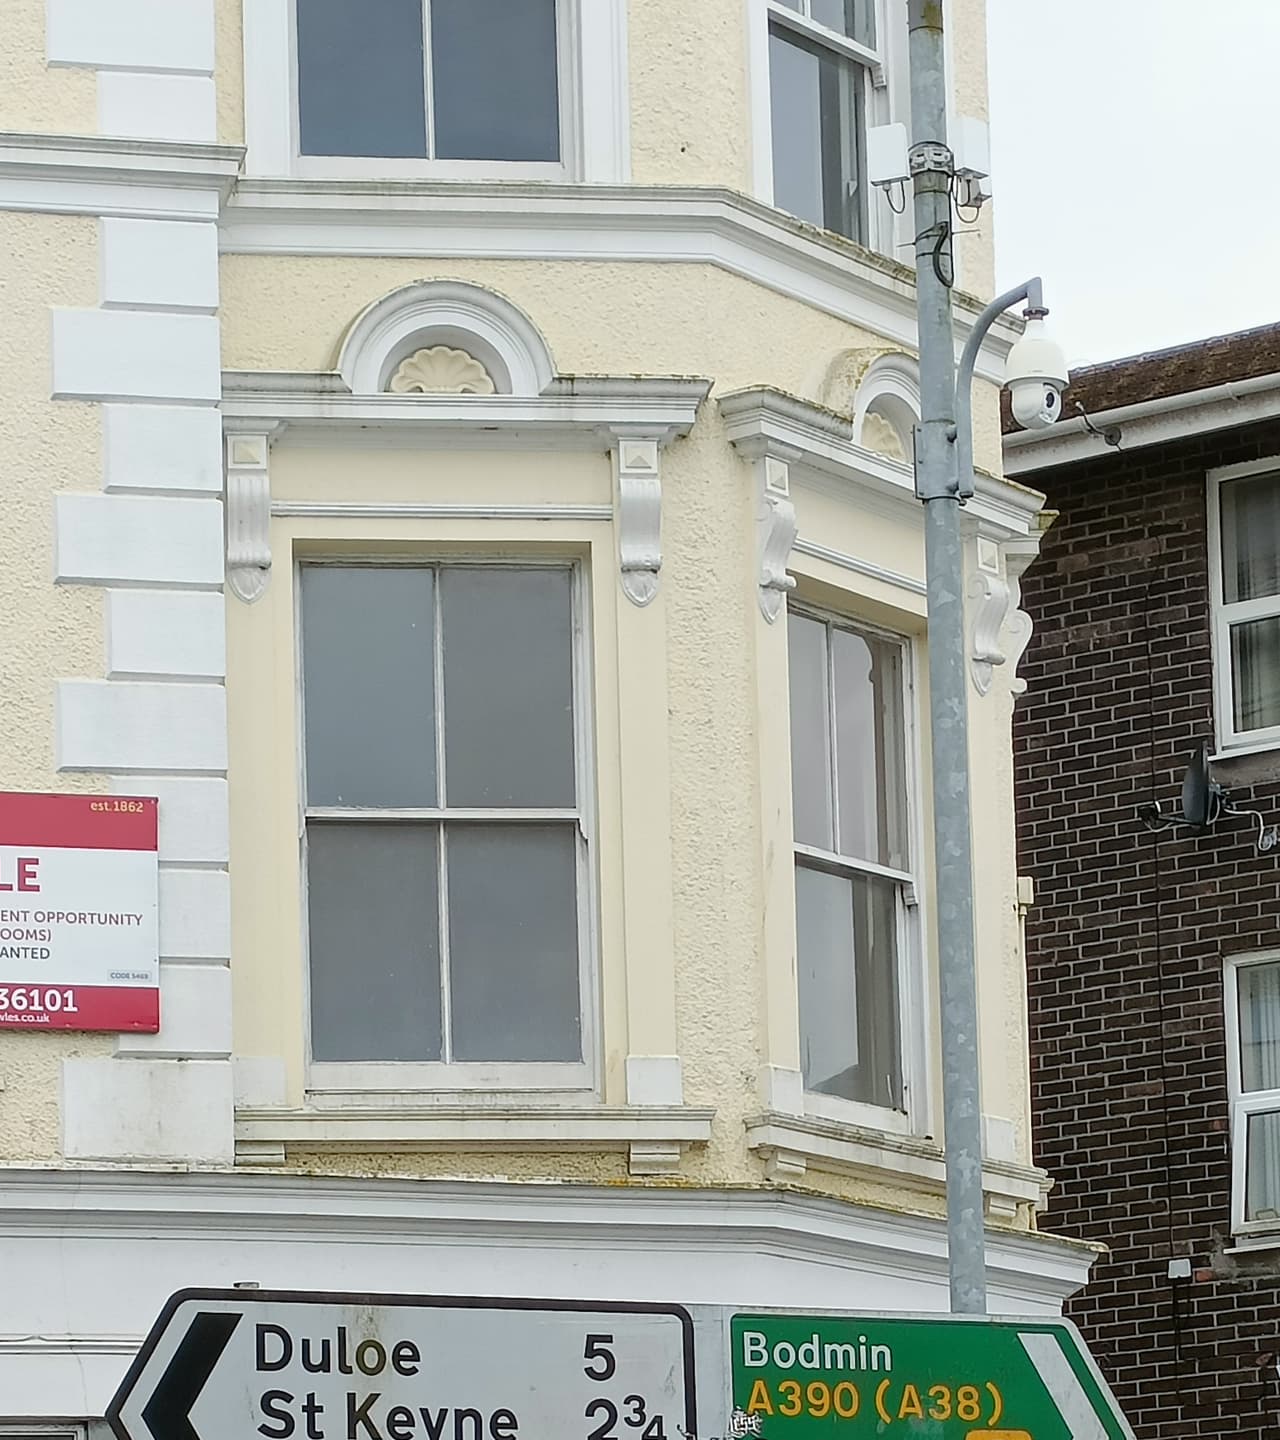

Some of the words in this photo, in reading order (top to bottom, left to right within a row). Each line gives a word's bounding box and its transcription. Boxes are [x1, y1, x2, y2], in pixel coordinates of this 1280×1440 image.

[34, 911, 143, 926] OPPORTUNITY
[255, 1323, 421, 1376] Duloe
[583, 1334, 617, 1381] 5
[742, 1331, 892, 1371] Bodmin
[259, 1389, 324, 1440] St
[747, 1379, 860, 1418] A390
[876, 1378, 1004, 1425] (A38)
